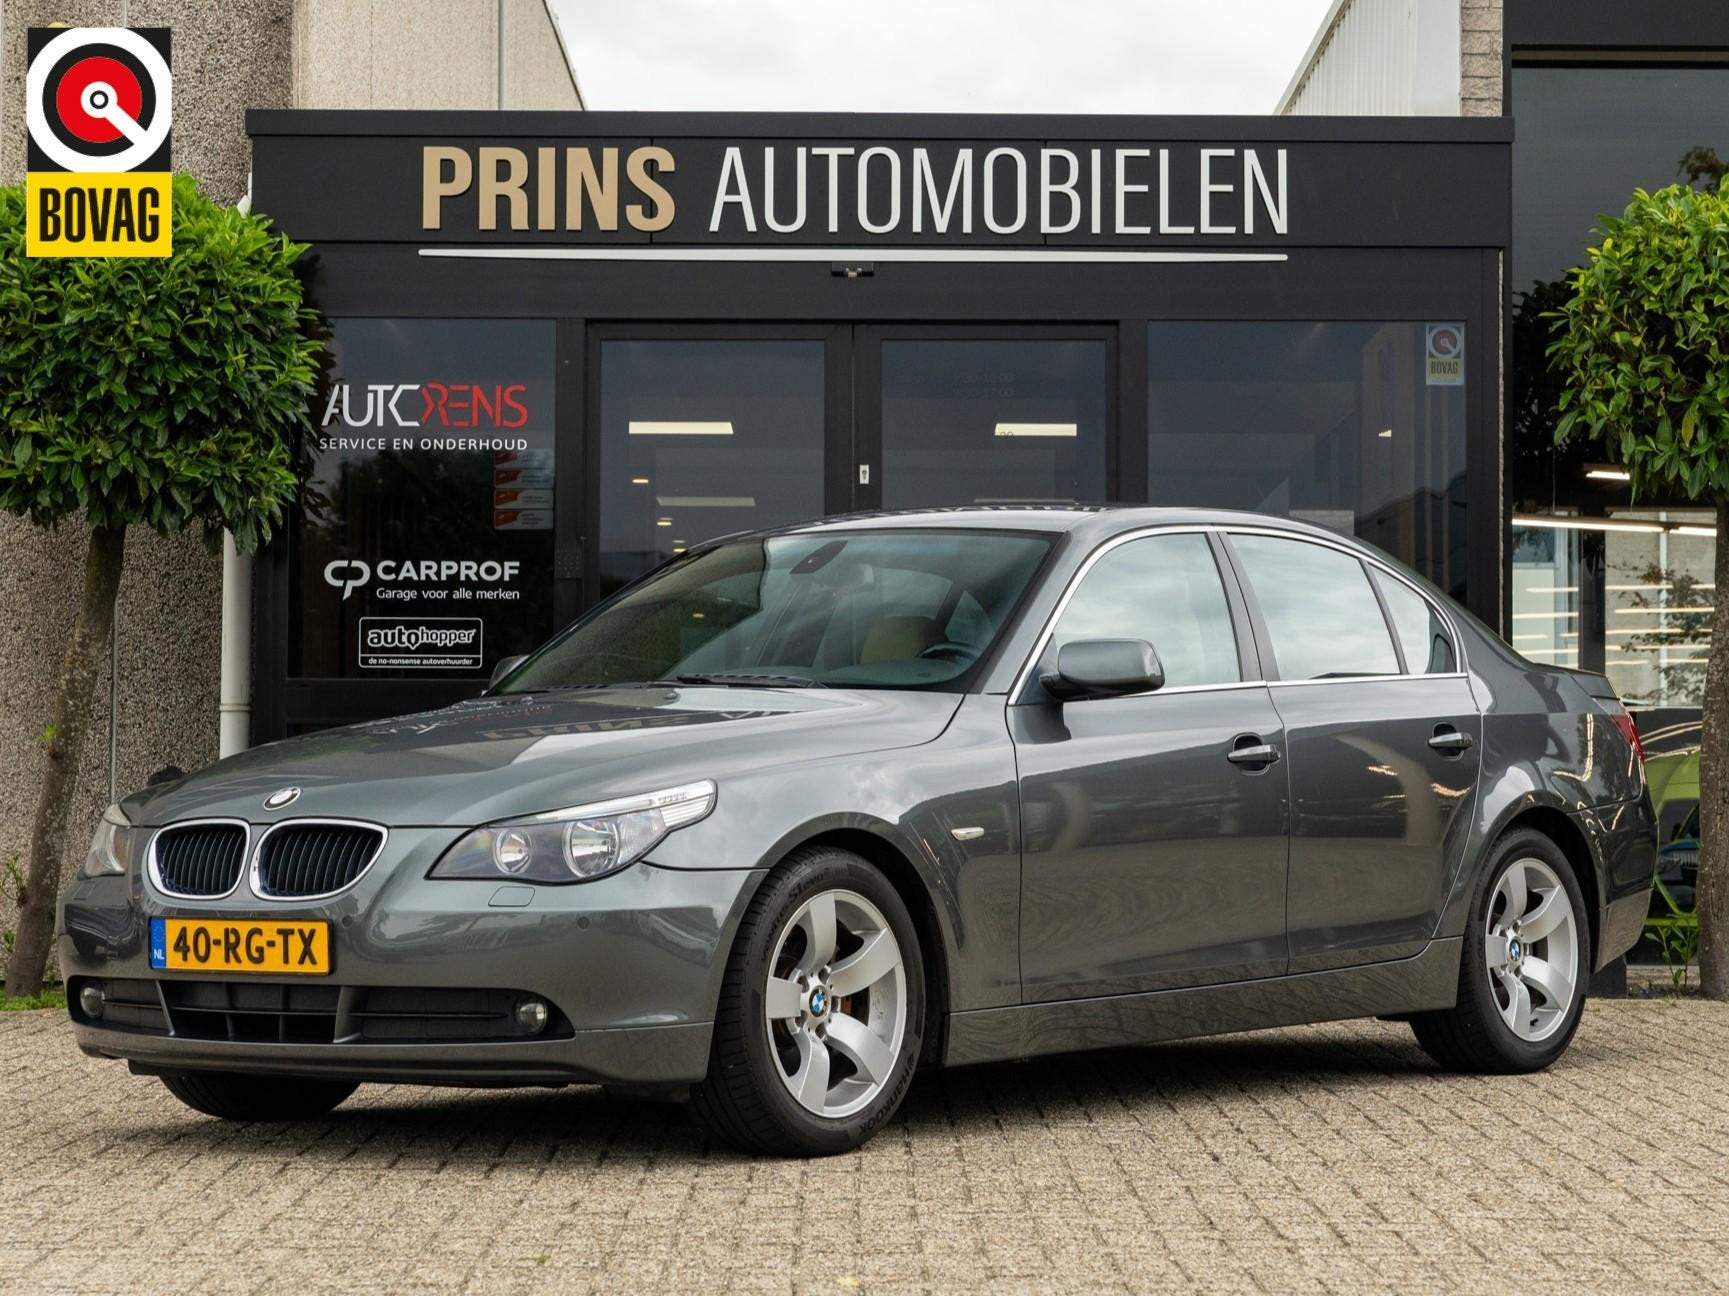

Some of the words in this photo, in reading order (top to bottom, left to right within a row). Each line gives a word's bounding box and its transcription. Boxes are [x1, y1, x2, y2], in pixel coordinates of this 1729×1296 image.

[423, 146, 676, 232] PRINS
[709, 146, 1288, 236] AUTOMOBIELEN
[1431, 359, 1458, 375] BOVAG
[319, 438, 386, 450] SERVICE
[393, 438, 414, 450] EN
[420, 438, 528, 451] ONDERHOUD
[376, 560, 520, 582] CARPROF
[376, 588, 418, 602] Garage
[421, 590, 449, 599] voor
[452, 588, 473, 600] alle
[475, 588, 520, 600] merken
[367, 625, 477, 650] autohopper
[368, 657, 377, 665] de
[378, 657, 421, 665] no-nonsense
[422, 657, 473, 665] autoverhuurder
[153, 949, 165, 960] NL
[173, 926, 318, 966] 40-RG-TX
